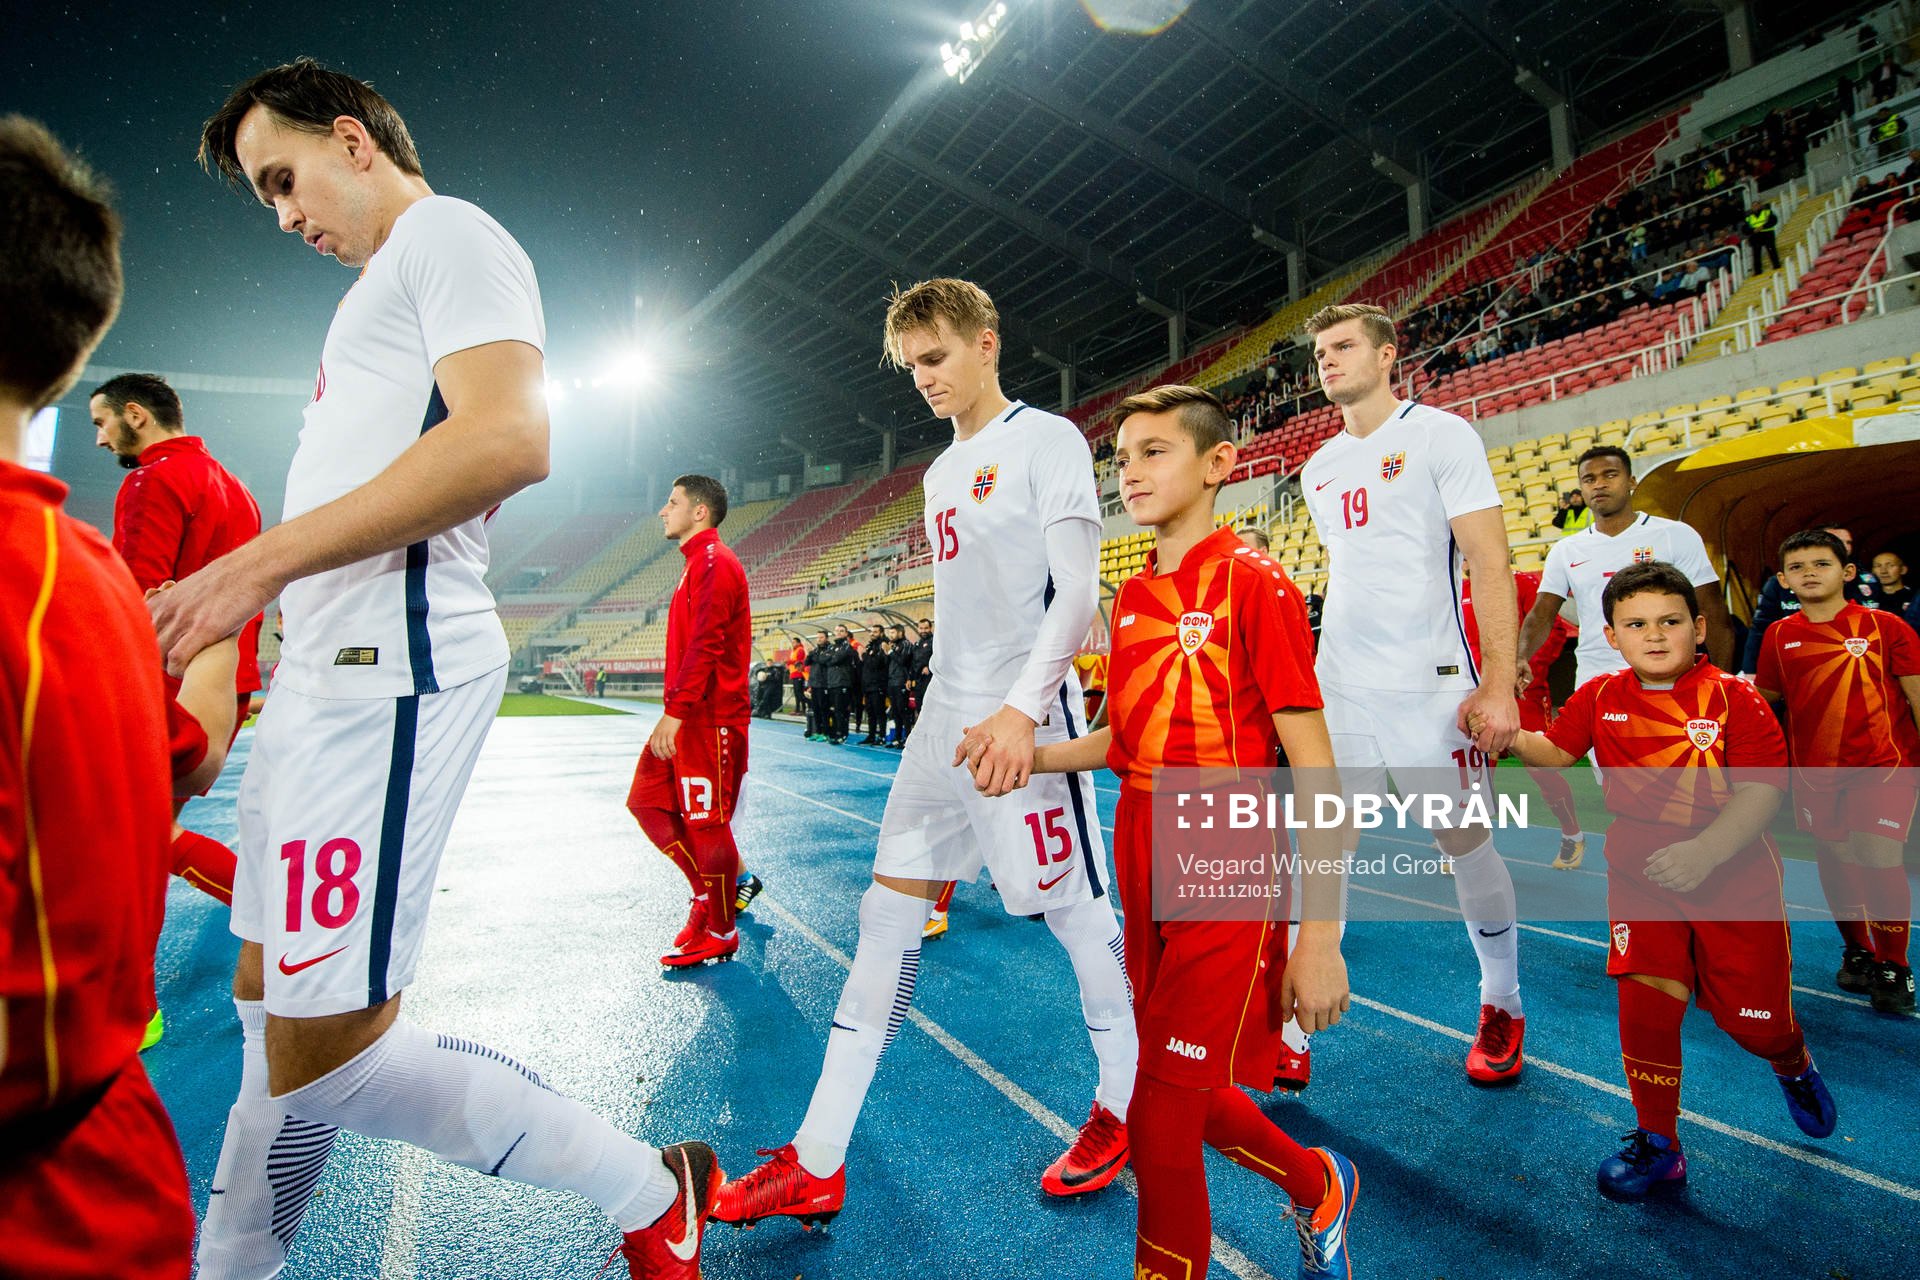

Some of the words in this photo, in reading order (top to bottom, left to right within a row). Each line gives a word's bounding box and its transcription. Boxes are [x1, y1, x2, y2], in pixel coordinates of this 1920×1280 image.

[1341, 487, 1369, 530] 19
[935, 507, 959, 562] 15
[1602, 712, 1628, 721] JAKO
[1451, 745, 1483, 790] 19
[690, 811, 709, 820] JAKO
[1877, 818, 1900, 829] JAKO
[1024, 806, 1073, 866] 15
[280, 837, 362, 932] 18
[1738, 1008, 1772, 1020] JAKO
[1166, 1036, 1207, 1060] JAKO
[1629, 1068, 1679, 1087] JAKO
